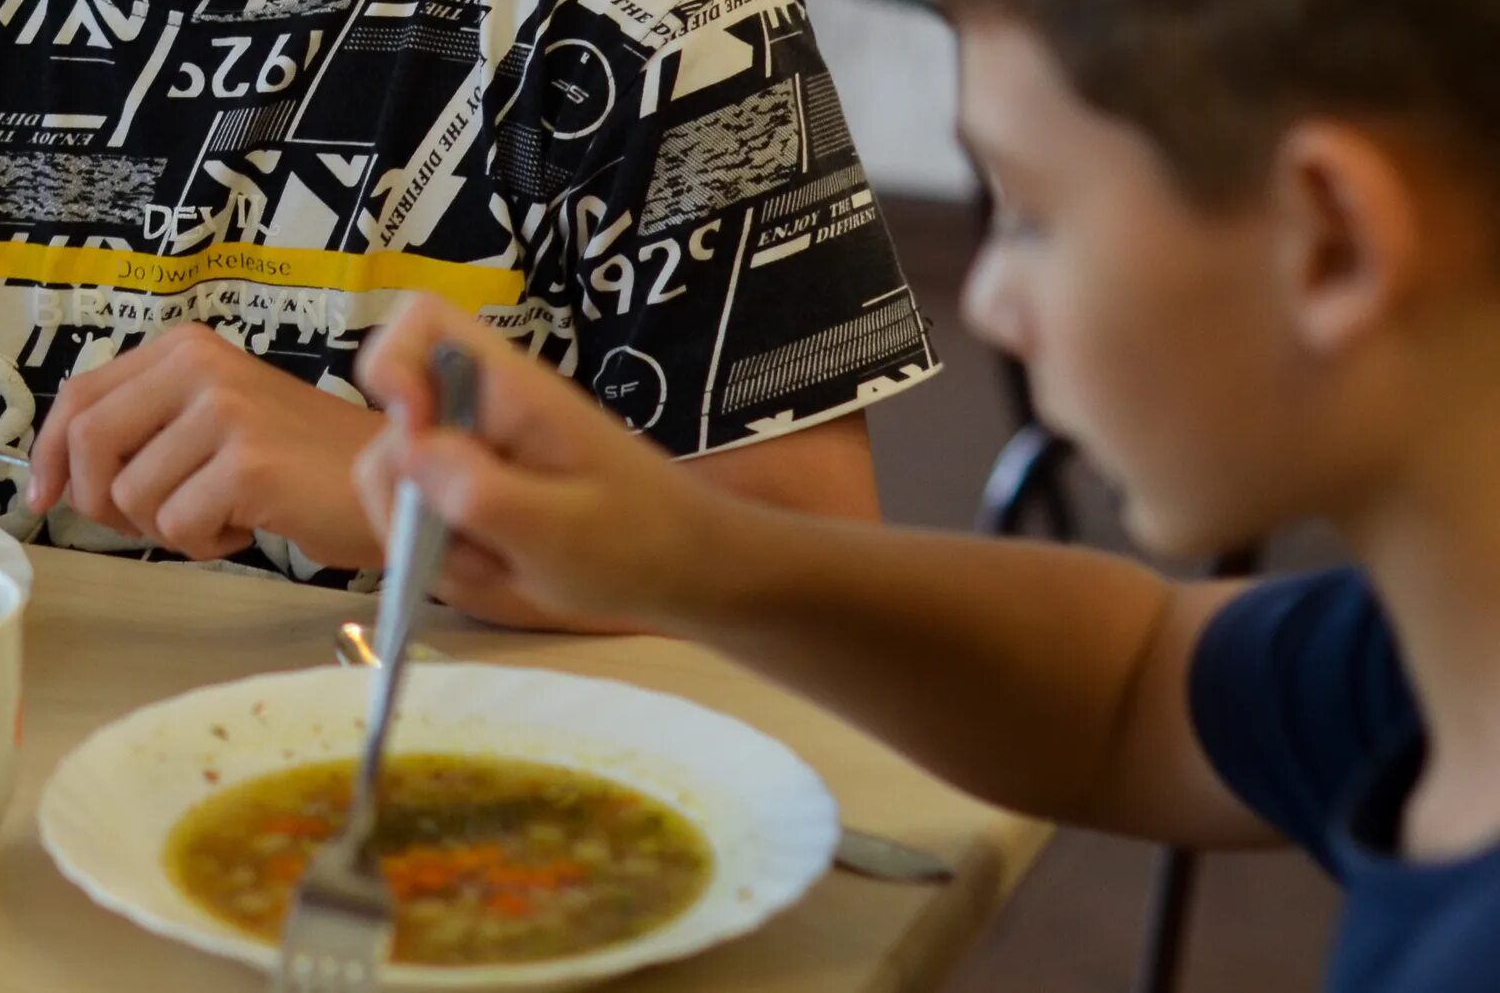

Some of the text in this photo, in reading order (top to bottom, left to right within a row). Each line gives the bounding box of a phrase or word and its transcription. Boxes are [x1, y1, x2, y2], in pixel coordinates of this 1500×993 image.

[26, 130, 95, 147] ENJOY
[438, 112, 470, 153] THE
[379, 148, 443, 248] DIFFIRENT
[757, 197, 852, 248] ENJOY THE
[815, 206, 877, 244] DIFFIRENT
[207, 251, 292, 276] Release
[604, 380, 640, 400] SF
